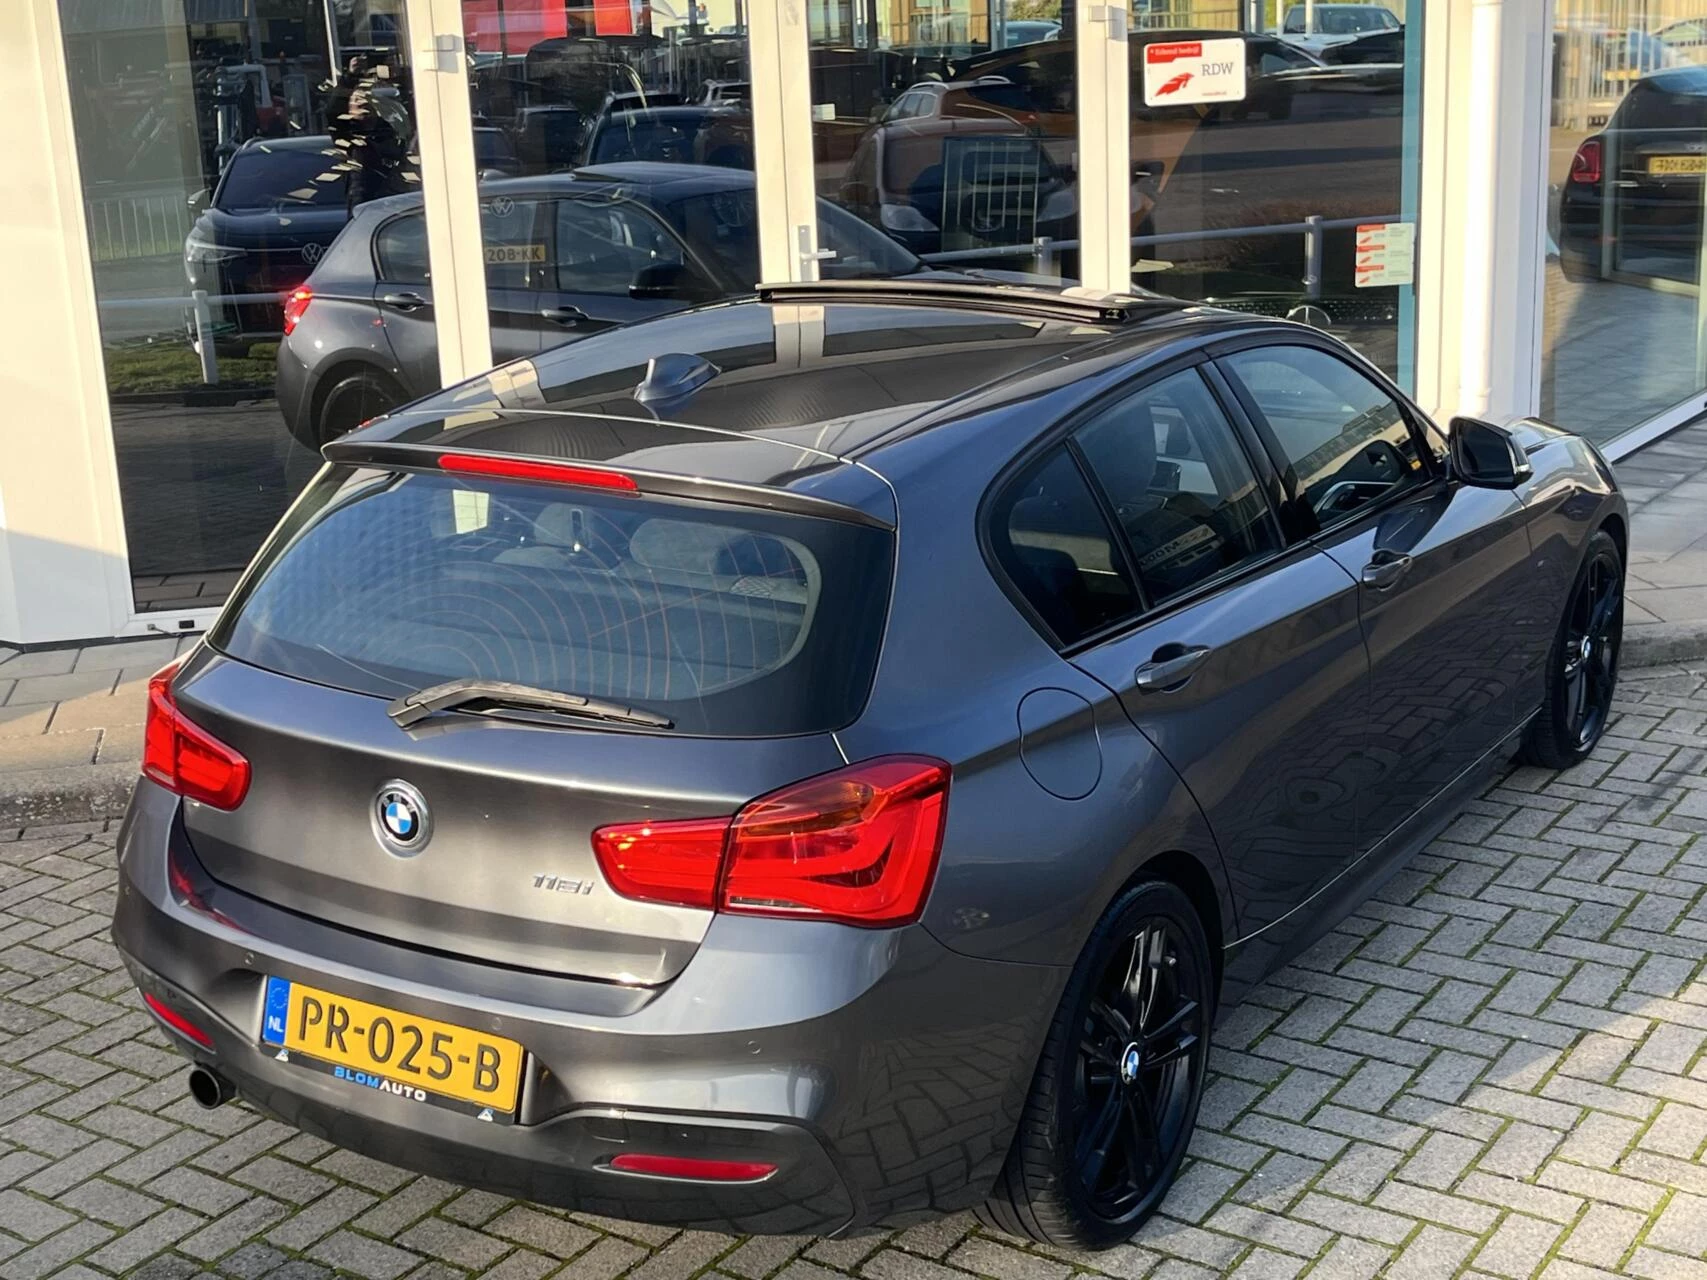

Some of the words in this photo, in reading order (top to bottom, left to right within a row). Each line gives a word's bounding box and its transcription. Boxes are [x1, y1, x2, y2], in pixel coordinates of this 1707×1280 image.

[1201, 62, 1234, 76] RDW
[486, 247, 542, 262] 208-KK
[267, 1015, 285, 1033] NL
[298, 995, 501, 1093] PR-025-B
[333, 1066, 427, 1102] BLOMAUTO
